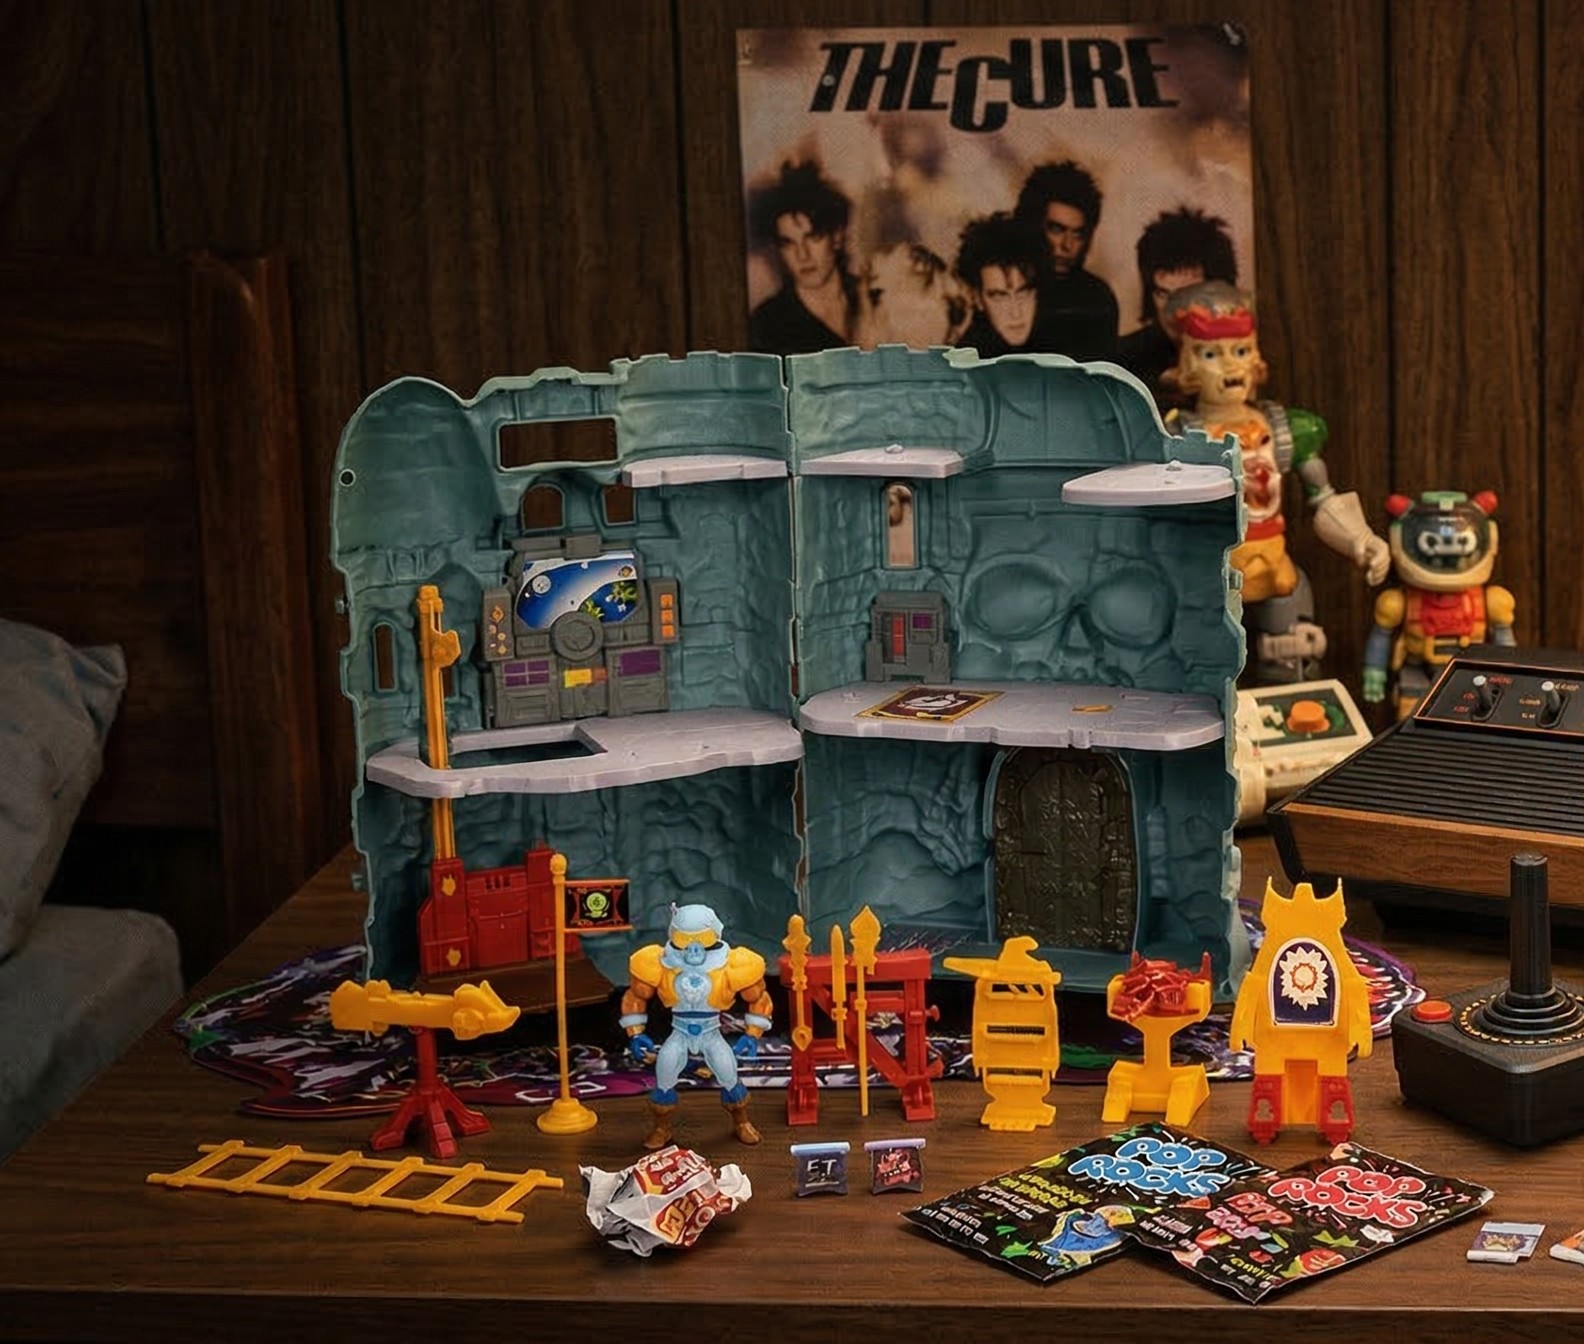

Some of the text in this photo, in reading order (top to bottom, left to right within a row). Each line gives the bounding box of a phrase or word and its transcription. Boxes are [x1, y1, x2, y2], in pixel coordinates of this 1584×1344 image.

[809, 37, 1181, 133] THE CURE
[1068, 1154, 1230, 1197] ROCKS
[1116, 1137, 1227, 1171] POP
[1268, 1177, 1427, 1228] ROCKS
[1315, 1165, 1426, 1197] POP
